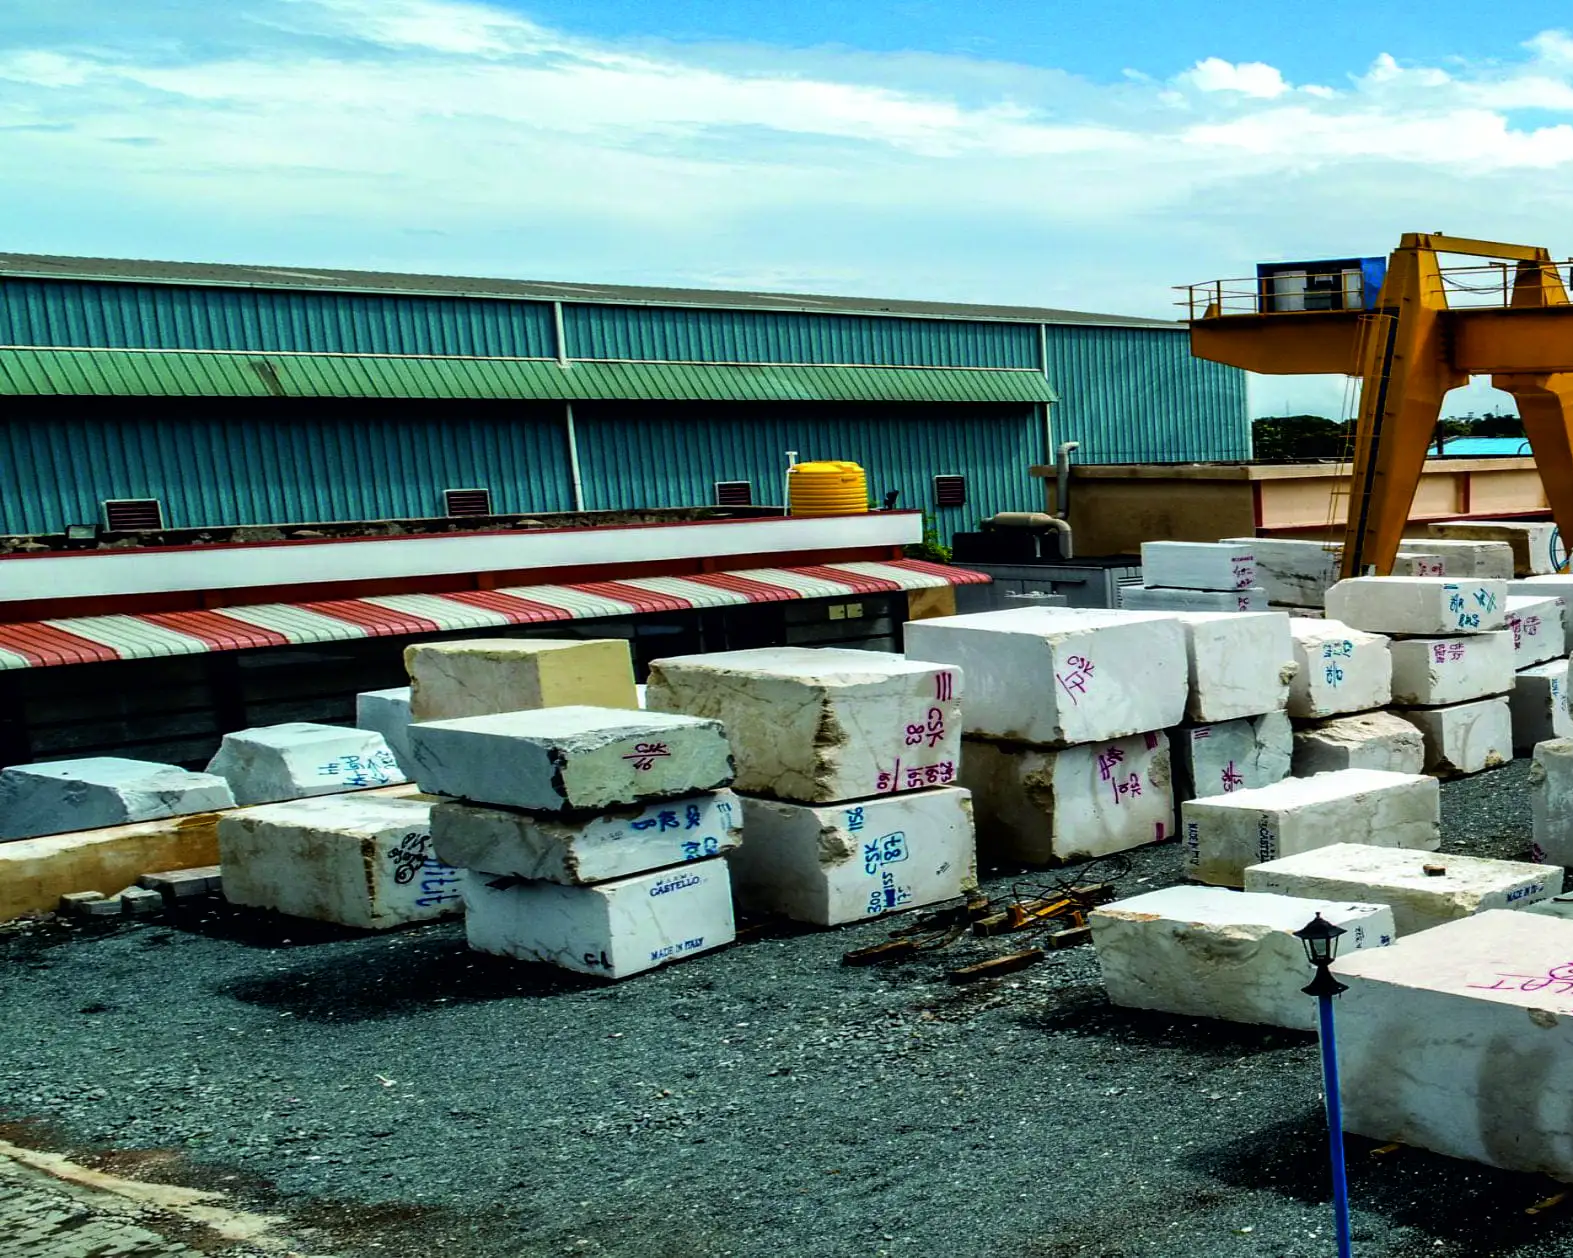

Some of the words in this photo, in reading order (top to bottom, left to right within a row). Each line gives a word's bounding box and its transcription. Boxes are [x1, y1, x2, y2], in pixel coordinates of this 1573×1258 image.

[1067, 655, 1095, 678] CSK
[905, 724, 925, 746] 83
[926, 707, 945, 748] CSK
[906, 767, 924, 788] 165
[1129, 773, 1142, 798] CSK
[846, 806, 865, 832] 1156
[864, 839, 881, 875] CSK
[884, 836, 902, 861] 87
[1260, 828, 1270, 864] CASTELL
[650, 875, 700, 897] CASTELLO
[867, 891, 882, 914] 300
[650, 946, 674, 961] MADE
[675, 943, 684, 954] IN
